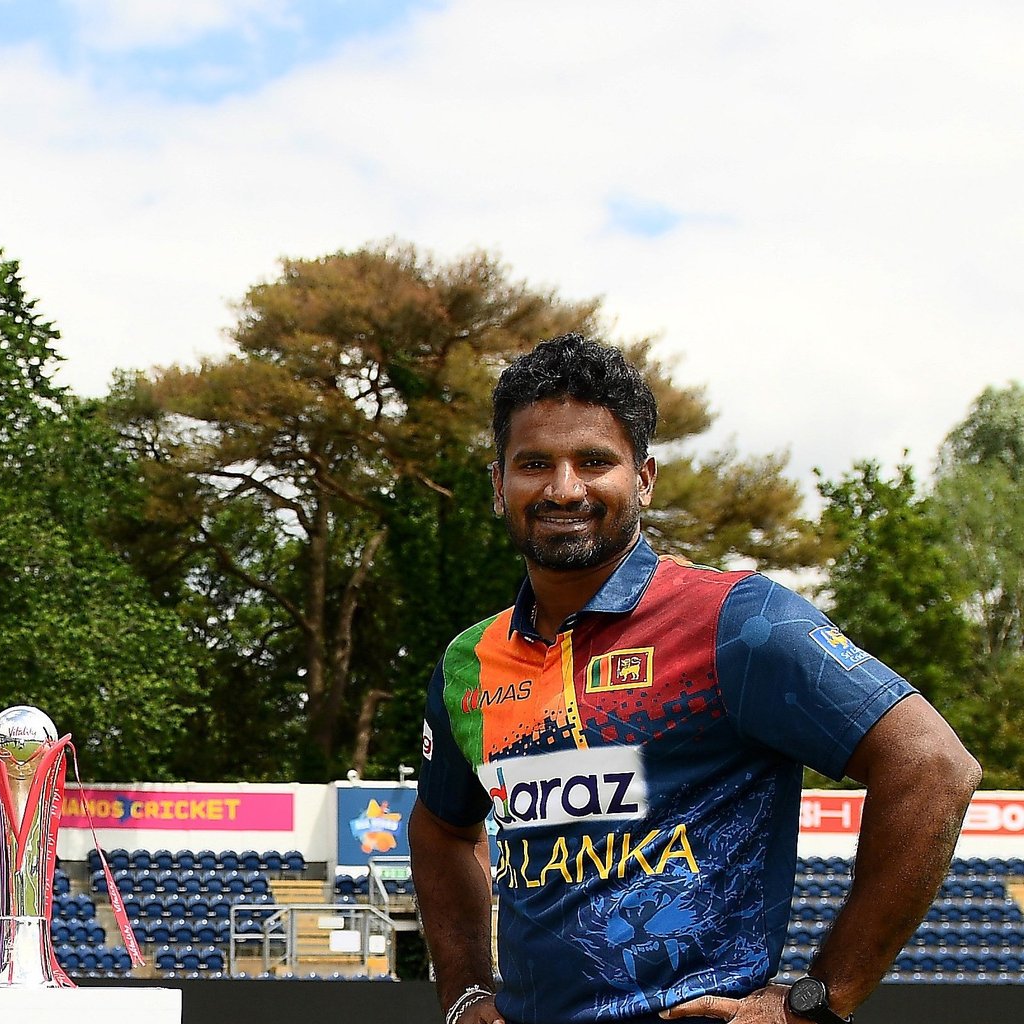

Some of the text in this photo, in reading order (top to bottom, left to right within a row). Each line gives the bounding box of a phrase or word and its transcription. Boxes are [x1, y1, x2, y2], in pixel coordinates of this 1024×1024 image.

[479, 680, 532, 708] MAS
[62, 798, 124, 819] AMOS
[130, 799, 241, 820] CRICKET
[490, 767, 639, 824] daraz
[521, 823, 700, 888] LANKA
